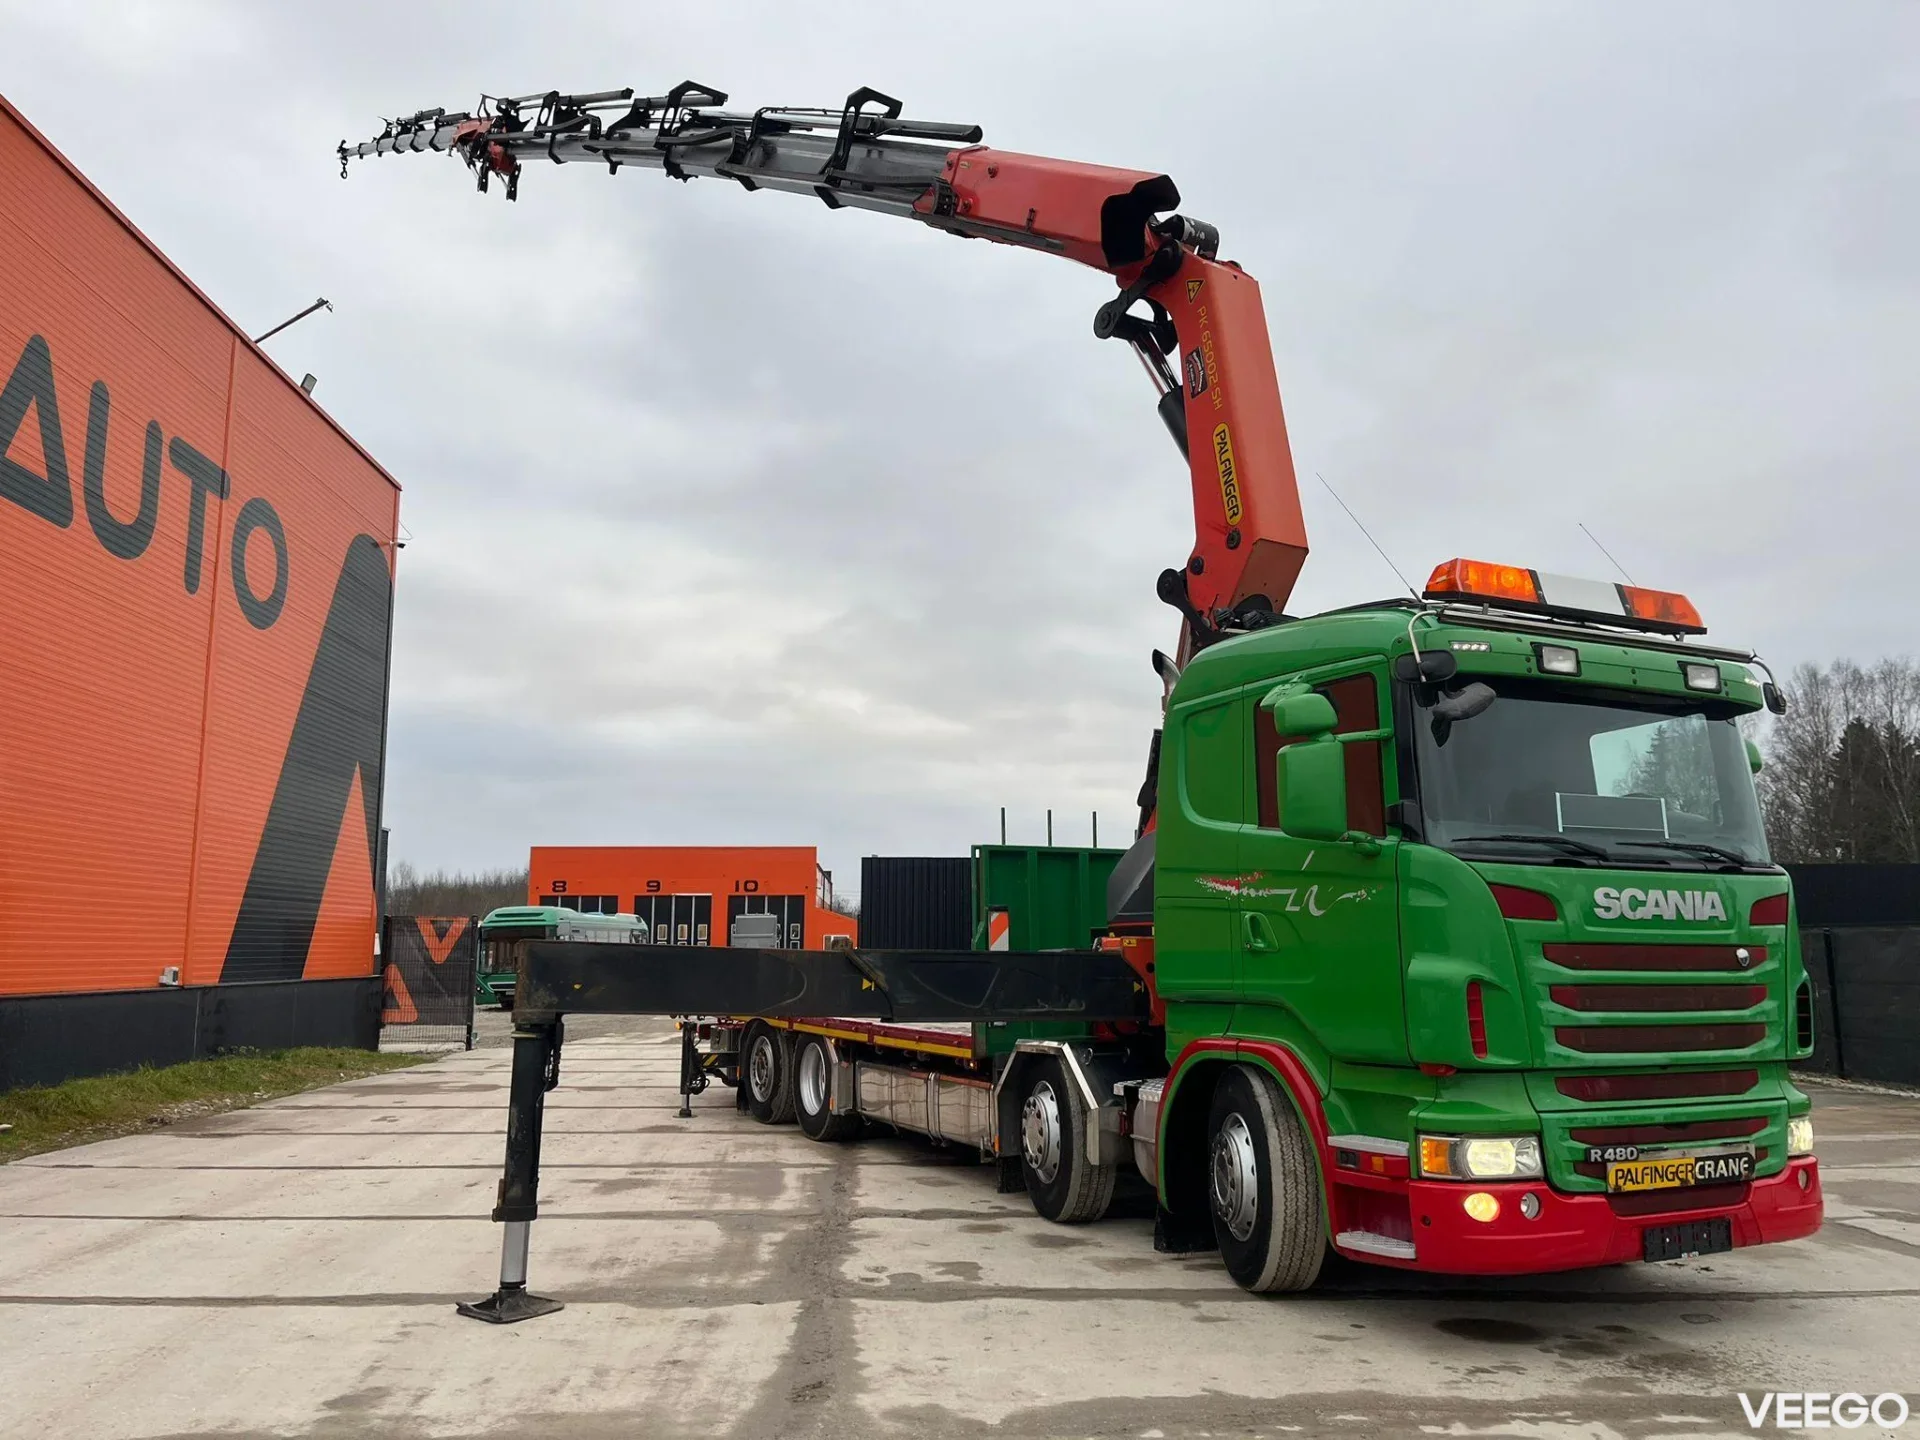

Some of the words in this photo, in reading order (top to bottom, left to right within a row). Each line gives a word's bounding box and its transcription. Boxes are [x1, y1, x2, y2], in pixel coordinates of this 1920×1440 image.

[1197, 305, 1210, 330] PK
[0, 333, 289, 630] AUTO
[1214, 428, 1240, 521] PALFINGER
[551, 880, 567, 893] 8
[645, 880, 661, 893] 9
[734, 880, 759, 893] 10
[1593, 886, 1728, 922] SCANIA
[1589, 1149, 1602, 1162] R
[1603, 1147, 1638, 1162] 480
